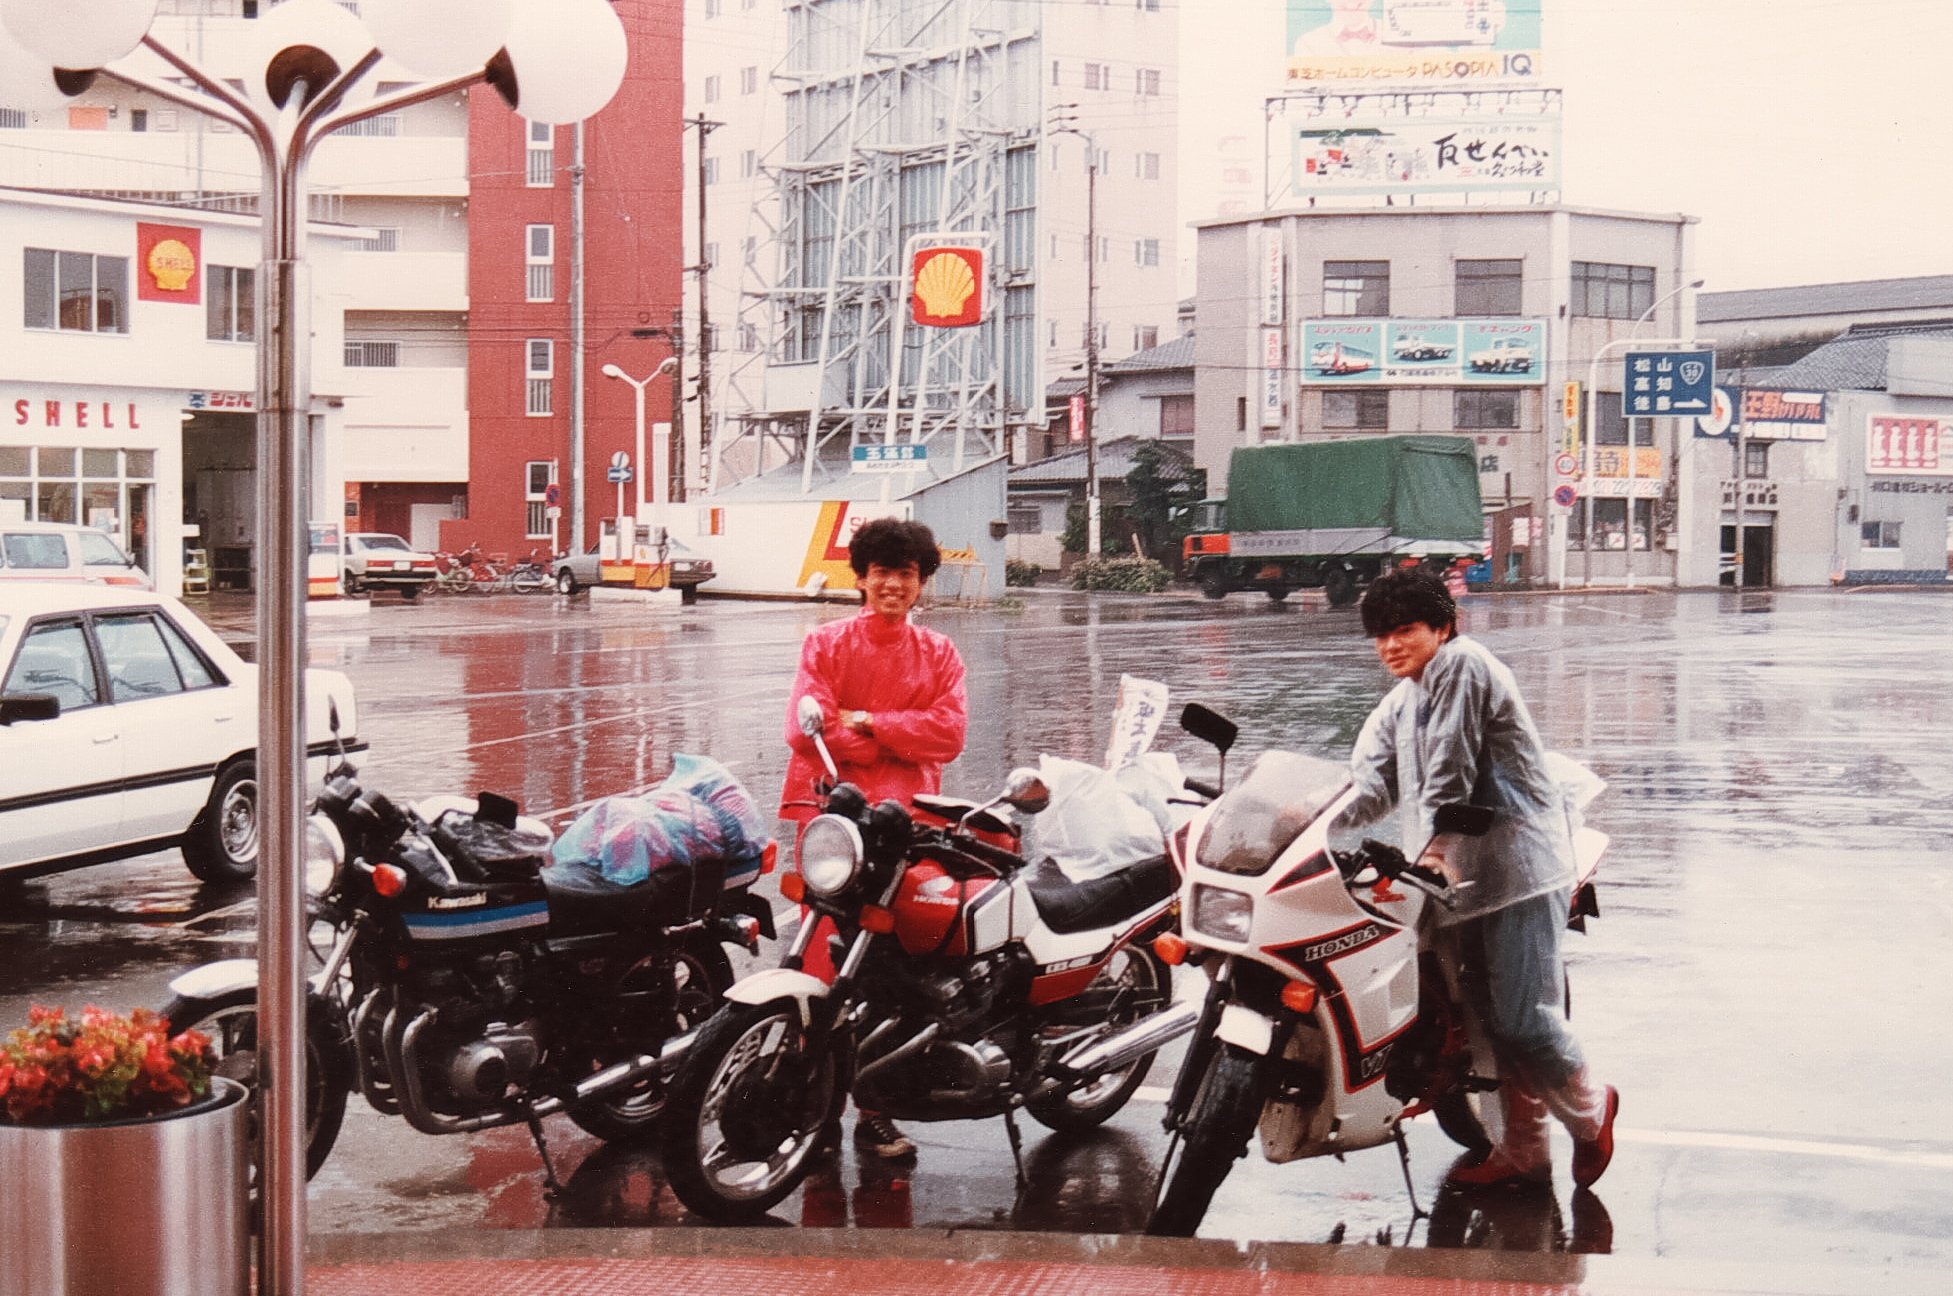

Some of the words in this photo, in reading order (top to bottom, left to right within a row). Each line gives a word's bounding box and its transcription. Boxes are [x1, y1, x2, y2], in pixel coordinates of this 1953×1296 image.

[1287, 67, 1416, 81] 東芝ホームコンピュータ
[1422, 61, 1497, 79] PASOPIA
[1503, 53, 1532, 76] IQ
[154, 256, 194, 270] SHELL
[1633, 376, 1673, 392] 高知
[15, 399, 141, 430] SHELL
[428, 892, 488, 910] Kawasaki
[1304, 924, 1380, 962] HONDA
